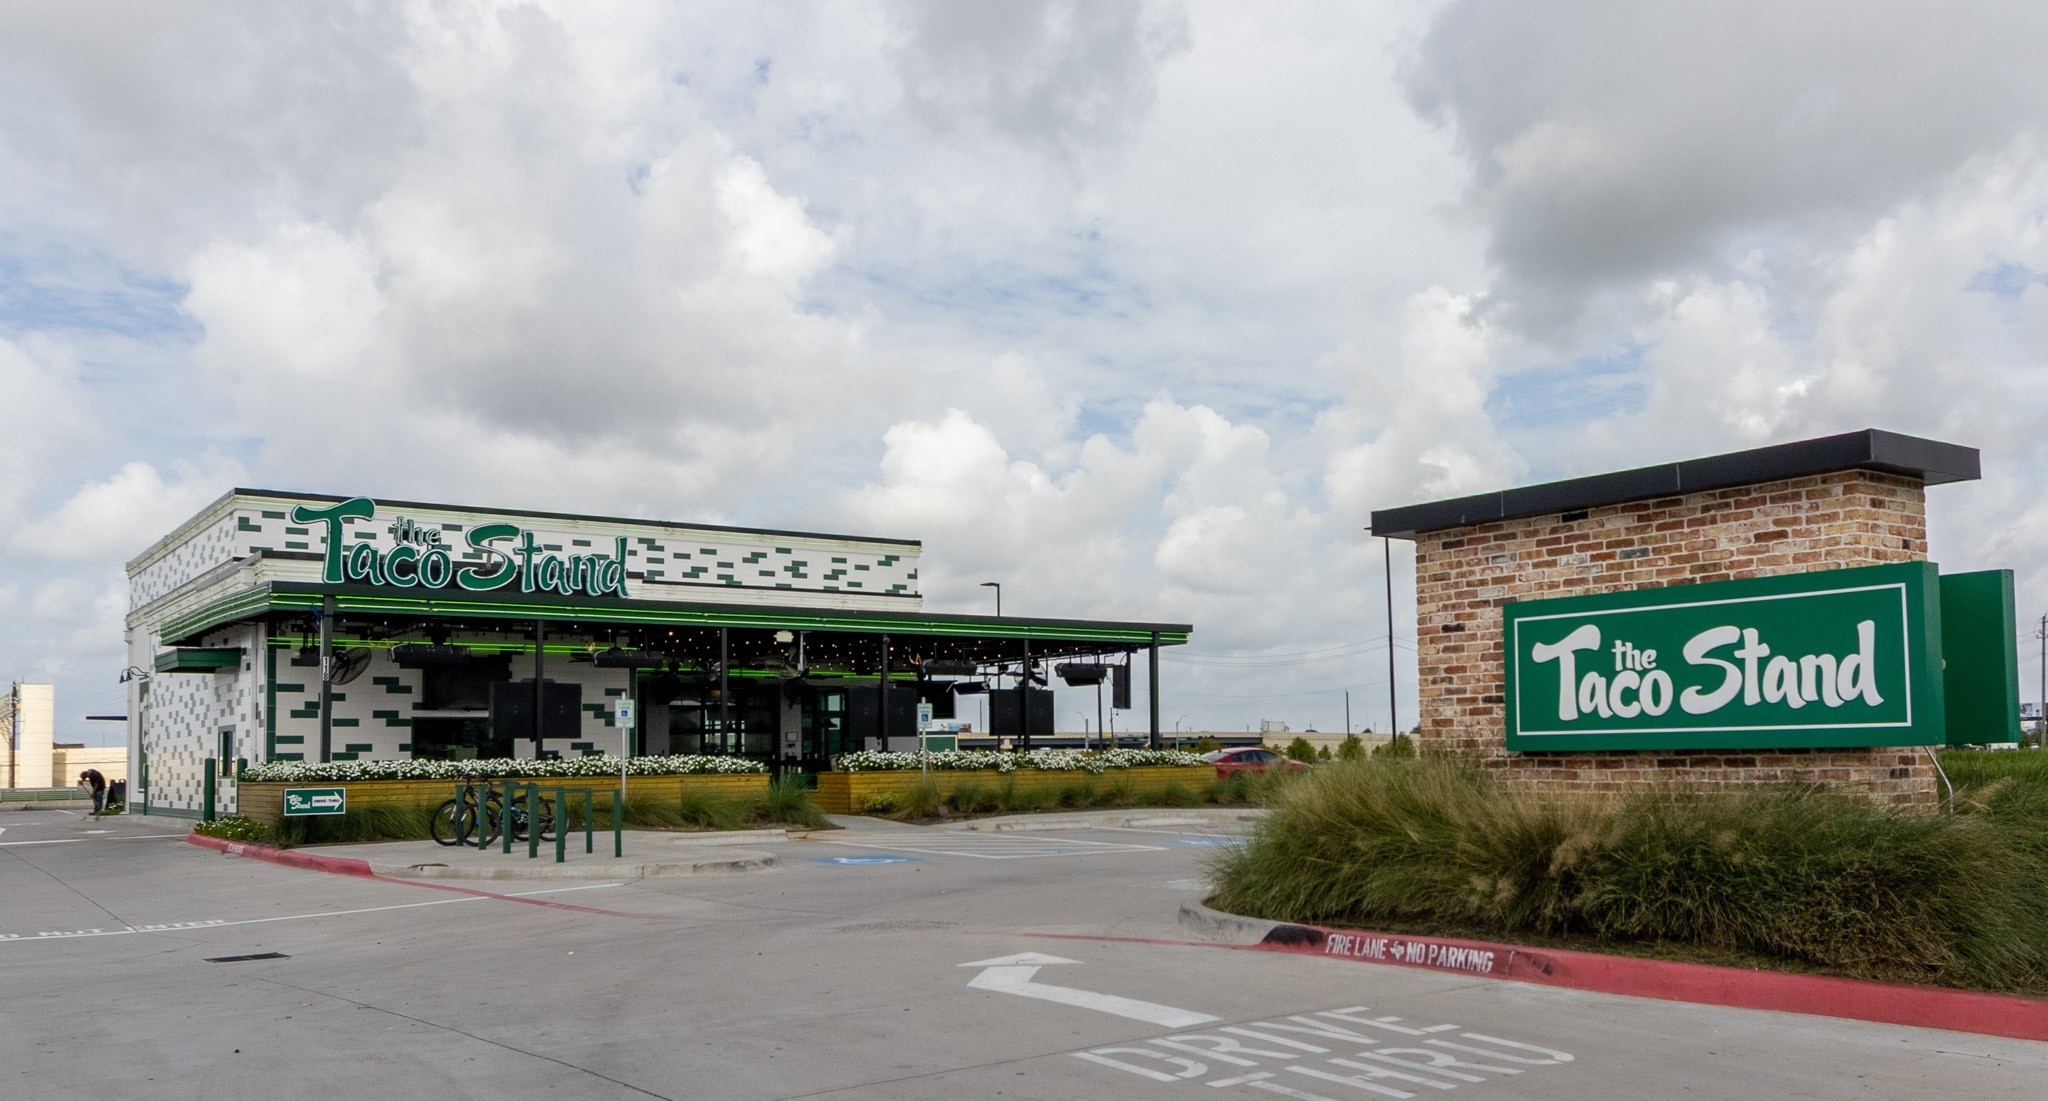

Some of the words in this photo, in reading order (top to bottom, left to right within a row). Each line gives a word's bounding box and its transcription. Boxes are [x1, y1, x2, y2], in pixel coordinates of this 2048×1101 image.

[291, 496, 452, 588] Taco
[457, 523, 631, 599] Stand
[393, 516, 441, 545] the
[1532, 624, 1673, 721] Taco
[1680, 620, 1884, 715] Stand
[1611, 640, 1657, 671] the
[1325, 933, 1353, 955] FIRE
[1354, 936, 1389, 960] LANE
[1405, 941, 1426, 964] NO
[1427, 944, 1495, 973] PARKING
[1069, 1006, 1461, 1082] DRIVE
[1205, 1032, 1575, 1101] THRU
